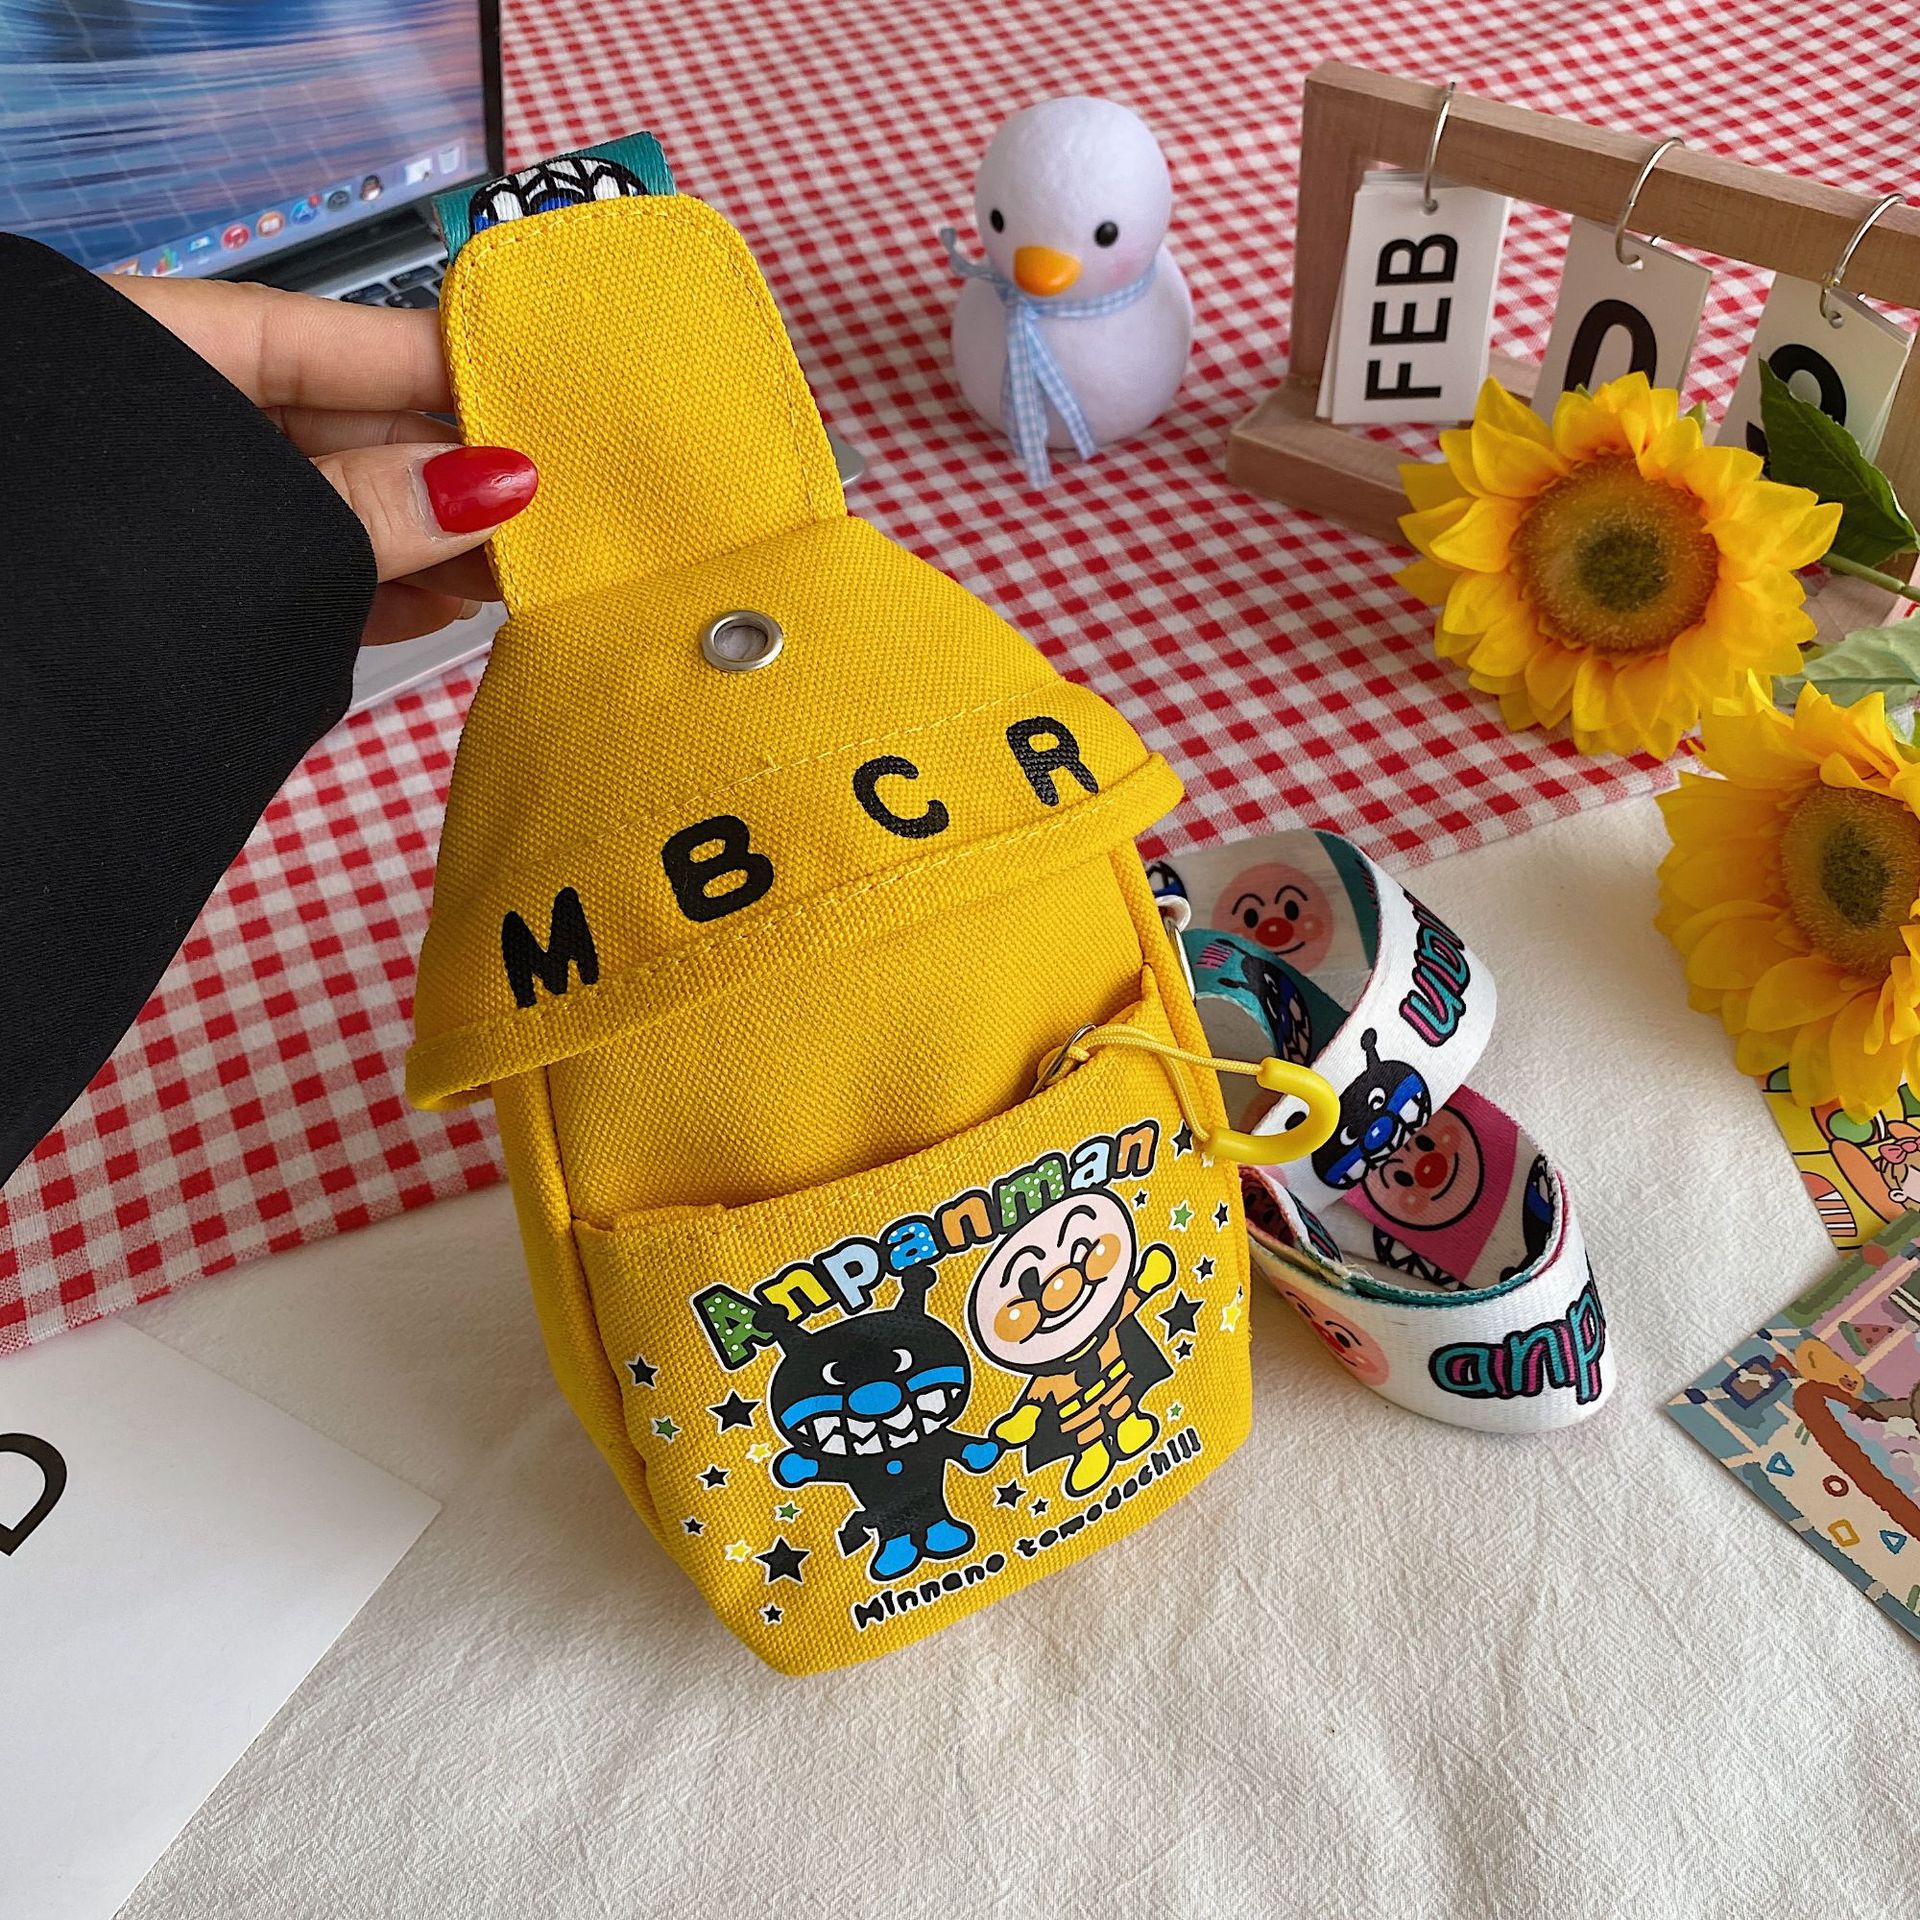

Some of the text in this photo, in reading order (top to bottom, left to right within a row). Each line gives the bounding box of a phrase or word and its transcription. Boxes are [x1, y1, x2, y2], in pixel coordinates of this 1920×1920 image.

[1364, 233, 1459, 401] FEB
[697, 1119, 1160, 1370] Anpanman
[1428, 1274, 1606, 1405] anp
[854, 1553, 1005, 1629] Minnano
